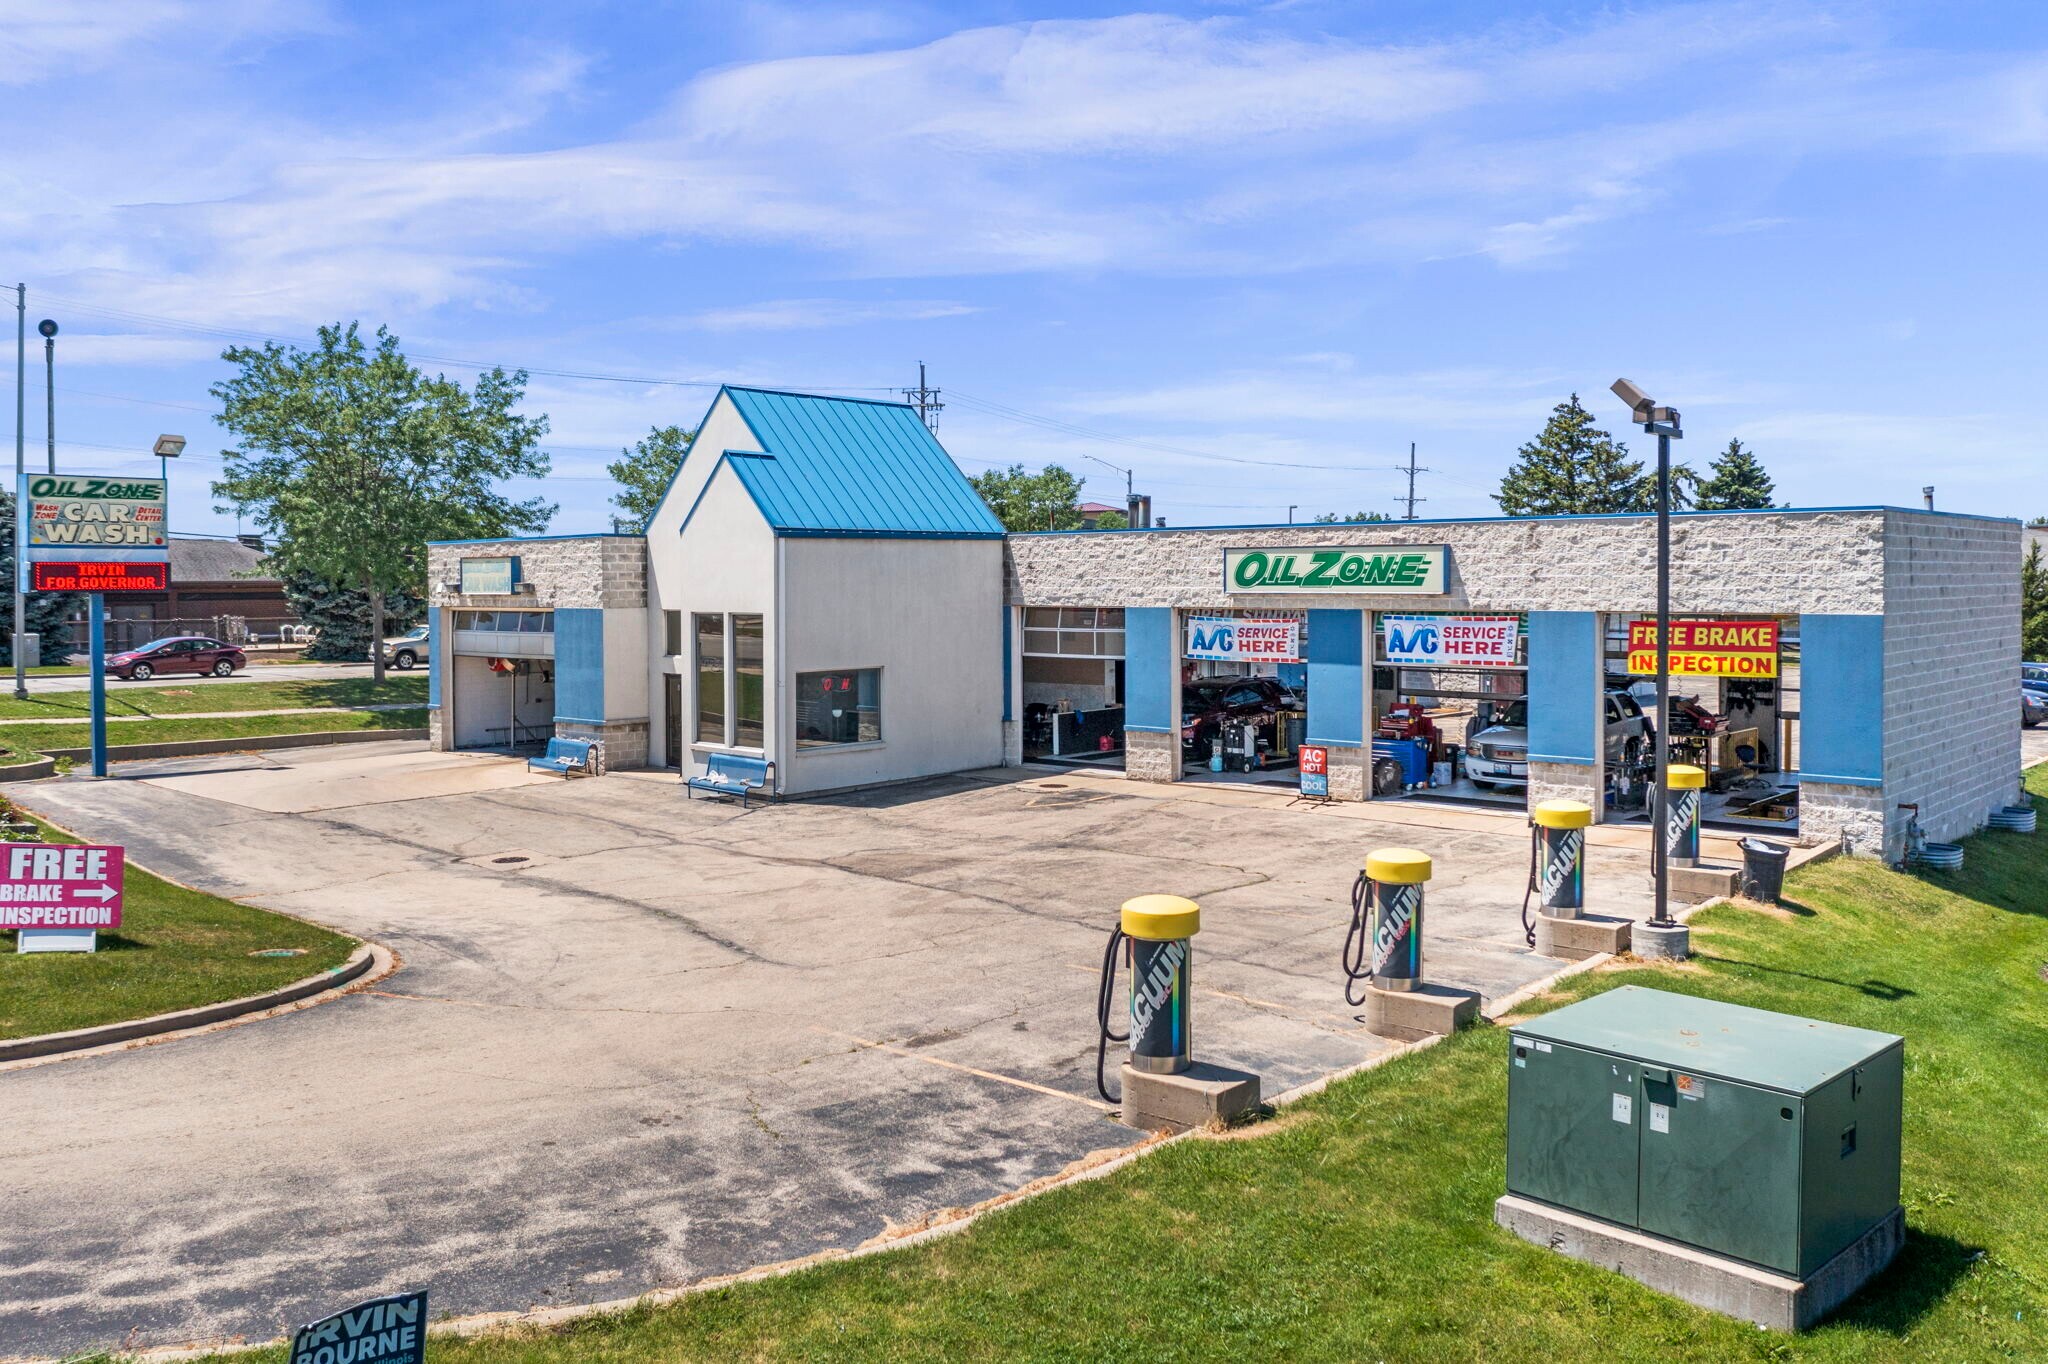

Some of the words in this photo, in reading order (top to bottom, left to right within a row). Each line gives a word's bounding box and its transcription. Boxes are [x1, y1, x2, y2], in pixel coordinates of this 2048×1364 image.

[35, 503, 60, 512] WASH
[64, 502, 130, 523] CAR
[137, 506, 162, 515] DETAIL
[34, 511, 58, 519] ZONE
[135, 514, 162, 522] CENTER
[44, 523, 150, 544] WASH
[78, 565, 126, 576] IRVIN
[46, 577, 76, 588] FOR
[79, 577, 156, 588] GOVERNOR
[1191, 625, 1235, 651] A/C
[1237, 627, 1289, 639] SERVICE
[1388, 624, 1440, 654] A/C
[1443, 626, 1507, 640] SERVICE
[1694, 627, 1772, 647] BRAKE
[1238, 640, 1288, 653] HERE
[1444, 641, 1503, 655] HERE
[1631, 655, 1772, 673] INPECTION
[1303, 750, 1322, 762] AC
[1303, 762, 1322, 771] HOT
[1301, 780, 1325, 791] COOL
[9, 848, 108, 880] FREE
[0, 884, 63, 902] BRAKE
[0, 907, 112, 925] INSPECTION
